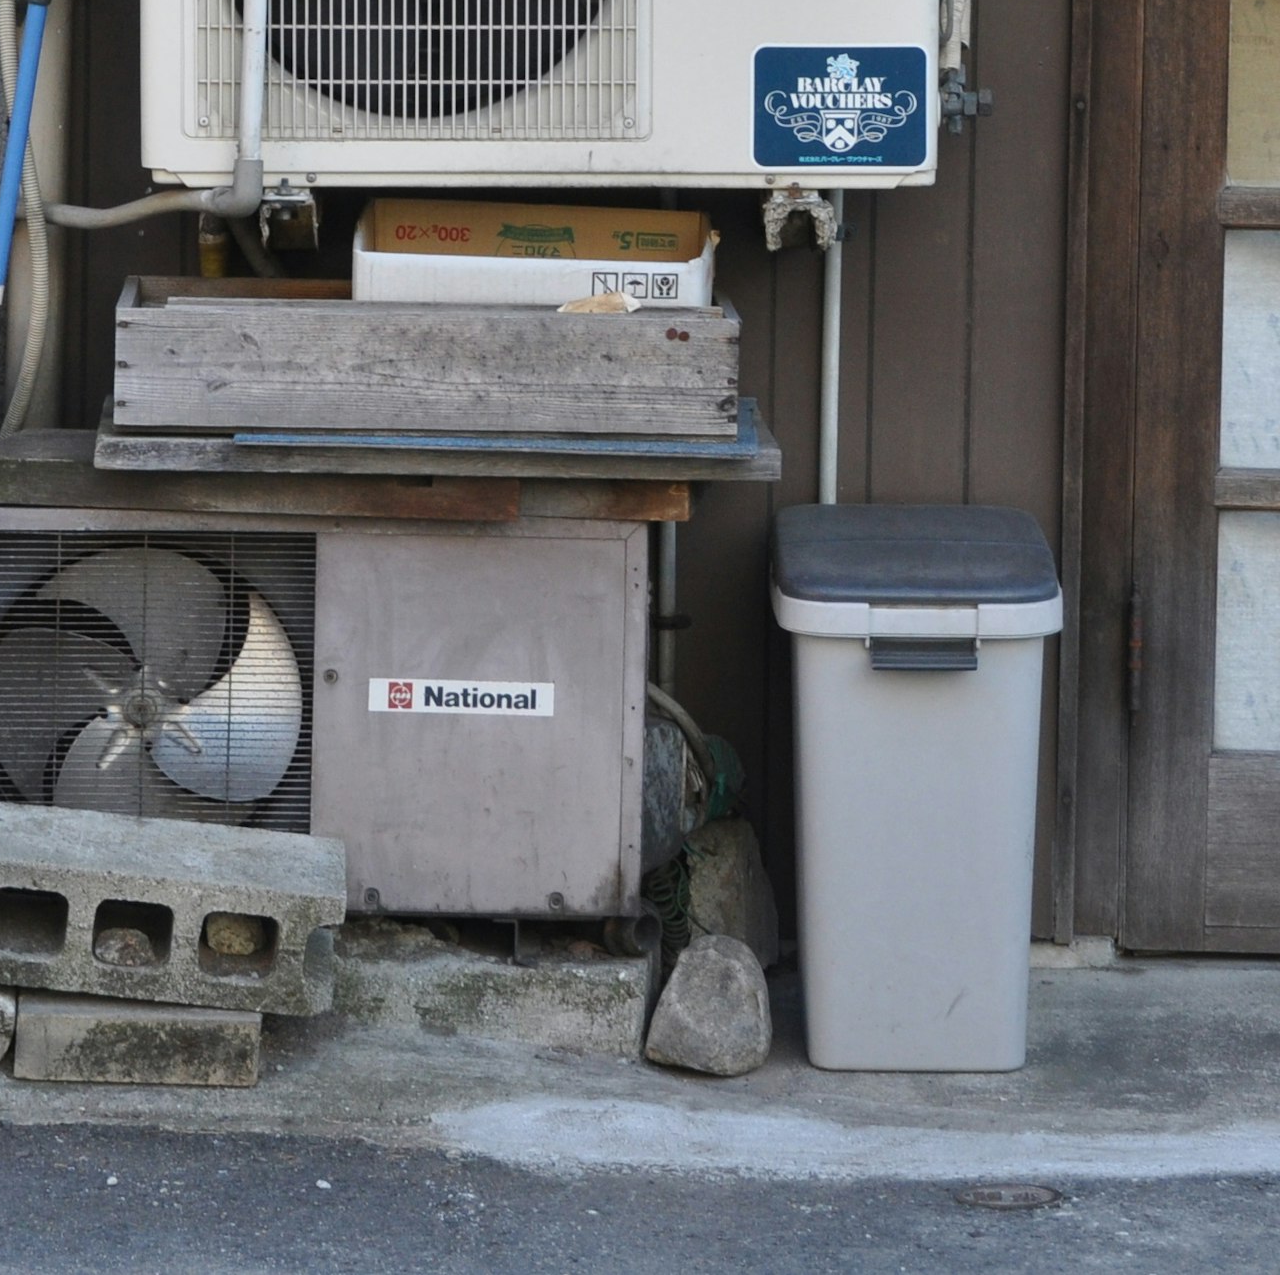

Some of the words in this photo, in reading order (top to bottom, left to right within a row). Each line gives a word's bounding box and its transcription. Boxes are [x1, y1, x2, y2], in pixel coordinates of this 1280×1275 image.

[797, 76, 887, 93] BARCLAY
[789, 92, 893, 109] VOUCHERS
[511, 245, 561, 259] マカロニ
[423, 685, 538, 710] National
